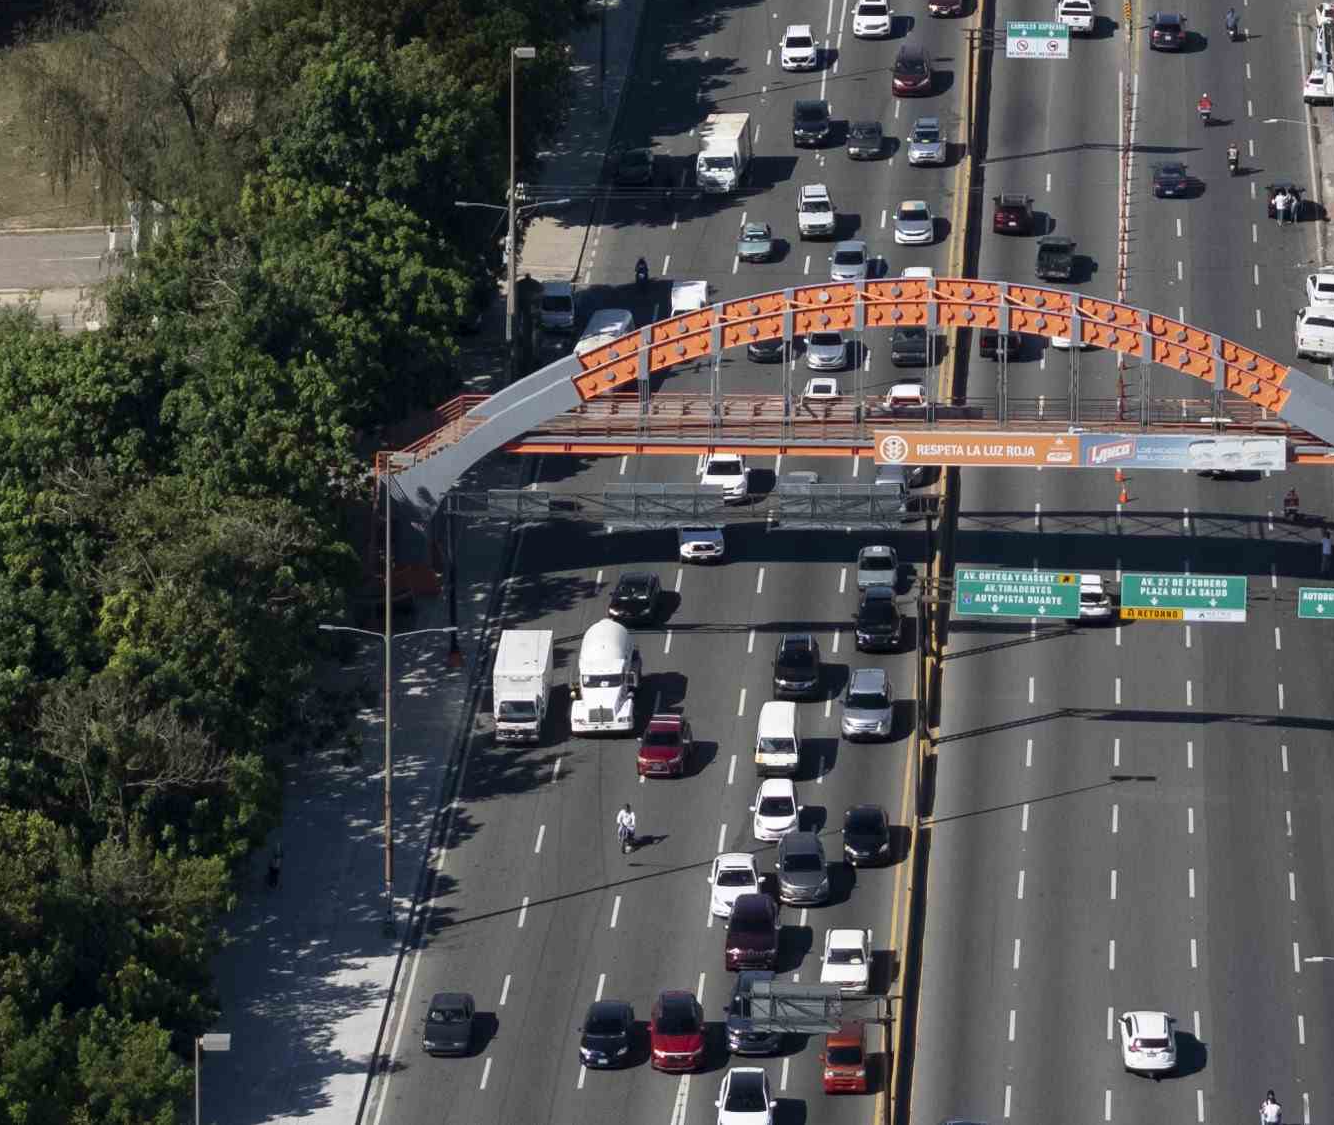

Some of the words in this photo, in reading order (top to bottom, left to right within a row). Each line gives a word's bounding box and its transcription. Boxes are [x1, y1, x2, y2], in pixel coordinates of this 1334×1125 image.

[917, 443, 964, 456] RESPETA
[966, 444, 981, 456] LA
[983, 444, 1004, 457] LUZ
[1006, 445, 1036, 458] ROJA
[963, 571, 977, 580] AV.
[979, 572, 1013, 581] ORTEGA
[1141, 577, 1155, 586] AV.
[1158, 577, 1168, 586] 27
[1172, 578, 1184, 587] DE
[1186, 578, 1228, 588] FEBRERO
[984, 583, 997, 592] AV.
[998, 584, 1053, 595] TIRADENTES
[1140, 586, 1167, 596] PLAZA
[1171, 587, 1183, 596] DE
[1185, 587, 1196, 596] LA
[1198, 588, 1228, 597] SALUD
[974, 593, 1025, 604] AUTOPISTA
[1027, 595, 1063, 605] DUARTE
[1140, 608, 1179, 618] RETORNO
